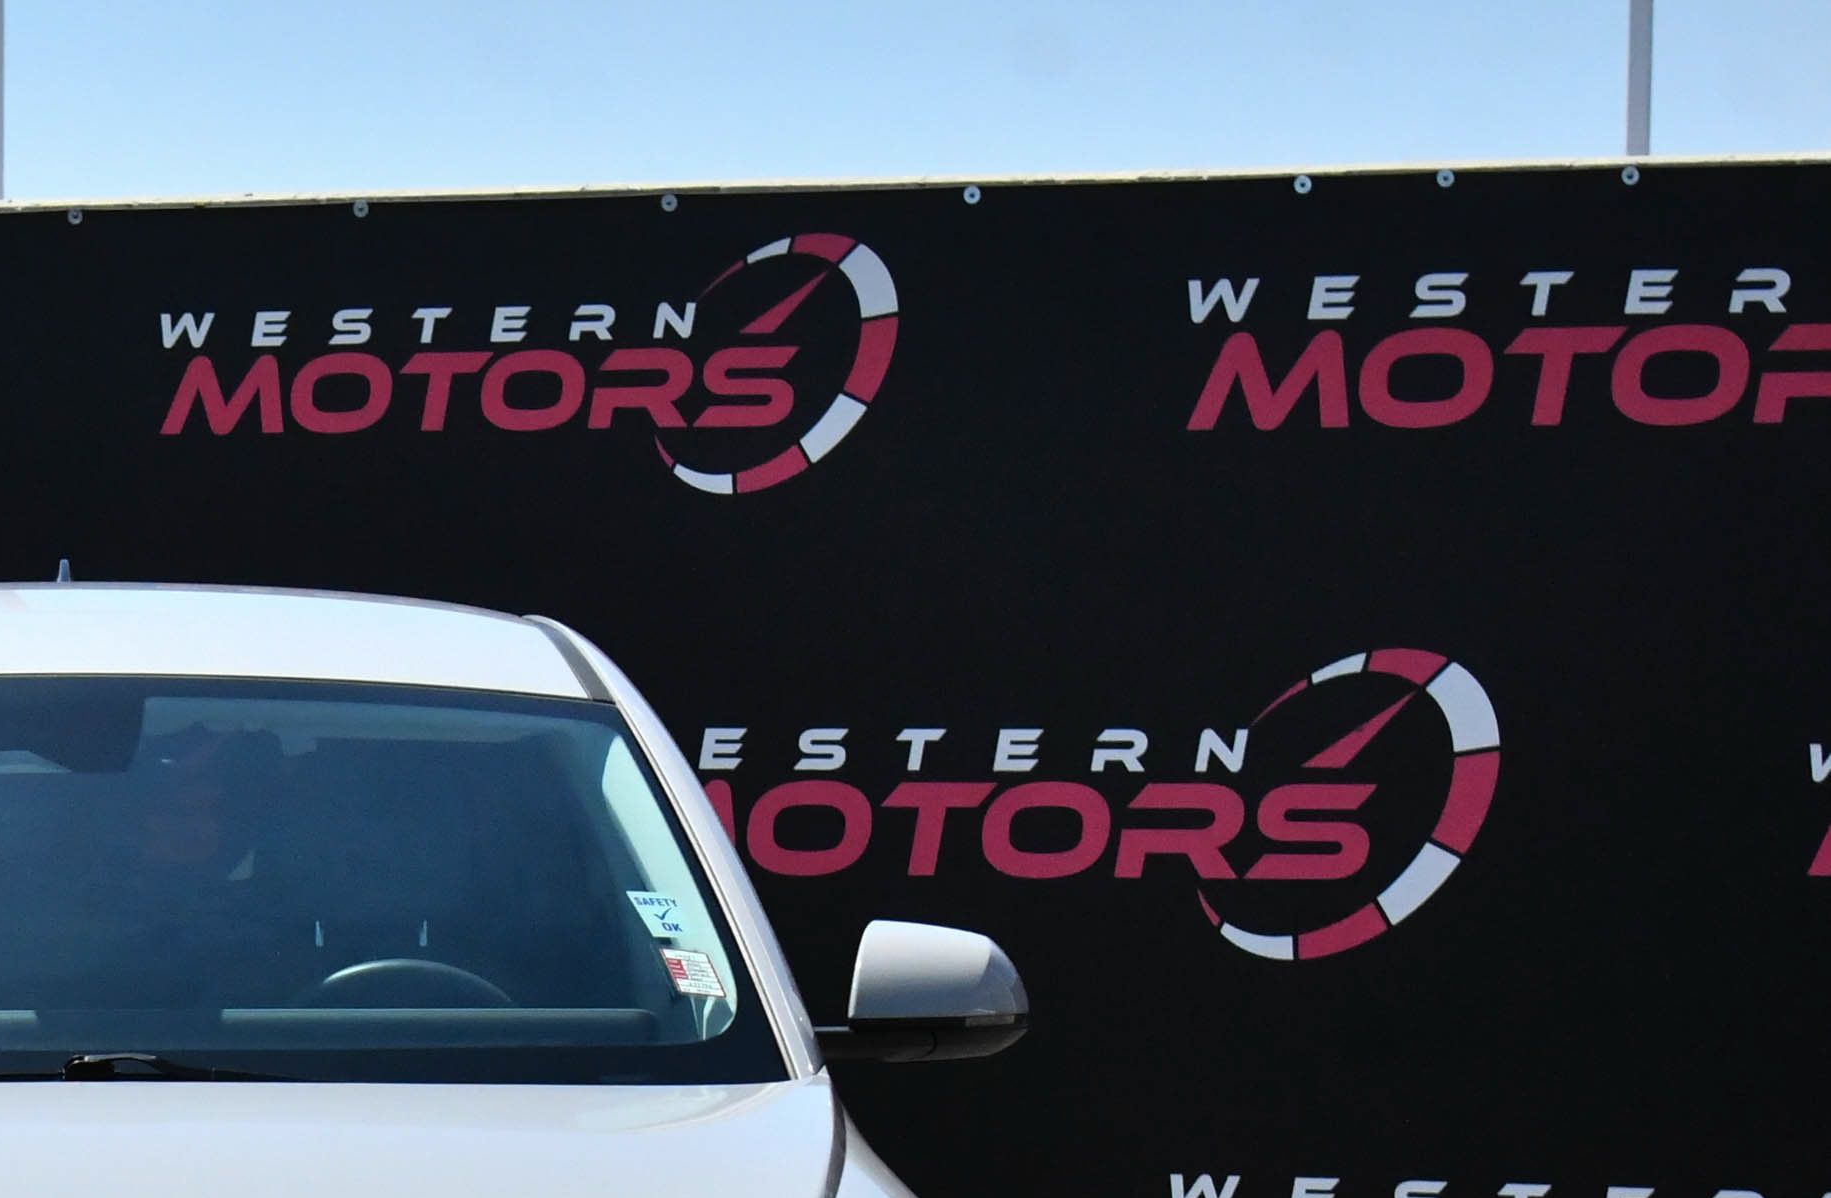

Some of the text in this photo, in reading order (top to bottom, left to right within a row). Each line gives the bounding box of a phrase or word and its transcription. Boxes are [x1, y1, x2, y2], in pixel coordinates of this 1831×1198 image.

[1188, 269, 1791, 323] WESTER
[161, 302, 696, 349] WESTERN
[162, 347, 796, 435] MOTORS
[698, 728, 1249, 773] ESTERN
[633, 896, 678, 908] SAFETY
[661, 921, 683, 933] OK
